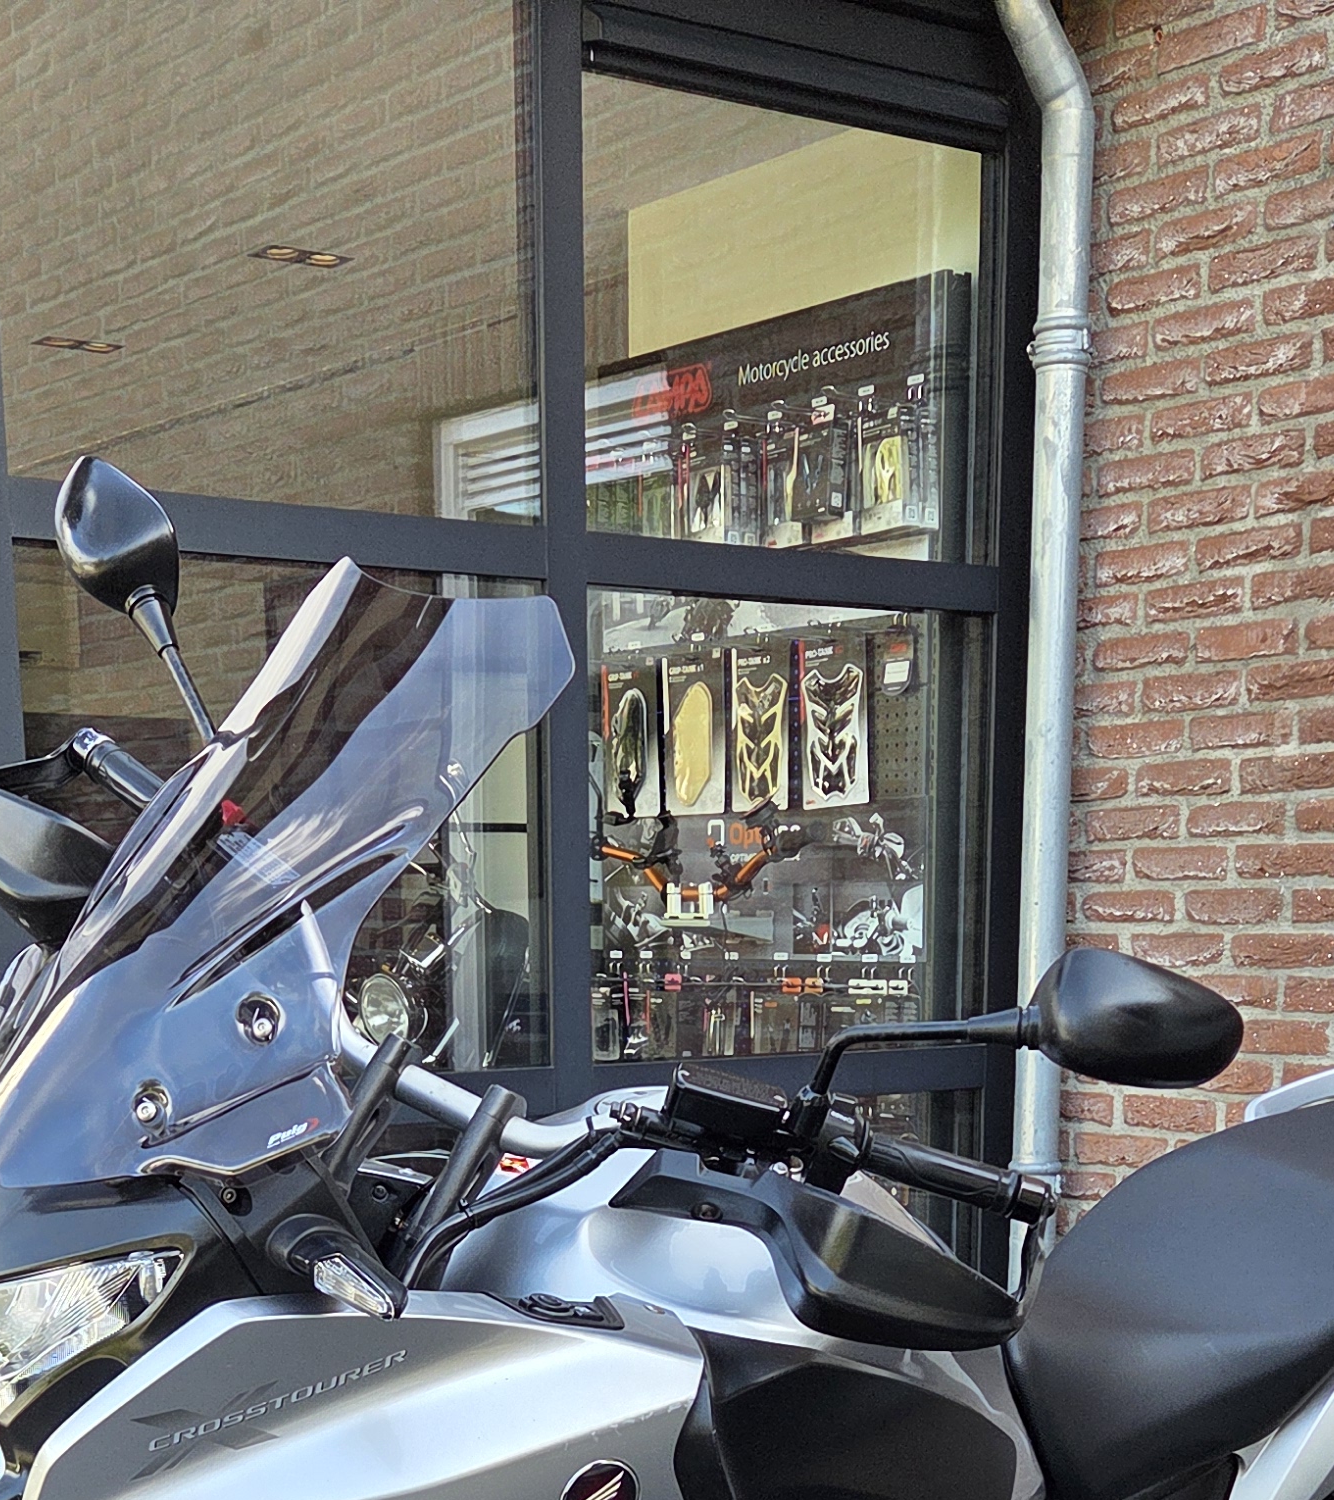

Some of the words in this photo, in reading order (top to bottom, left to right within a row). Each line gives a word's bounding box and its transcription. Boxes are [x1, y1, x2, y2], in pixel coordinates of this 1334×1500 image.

[738, 349, 809, 386] Motorcycle
[812, 331, 890, 368] accessories
[149, 1350, 407, 1452] CROSSTOURER
